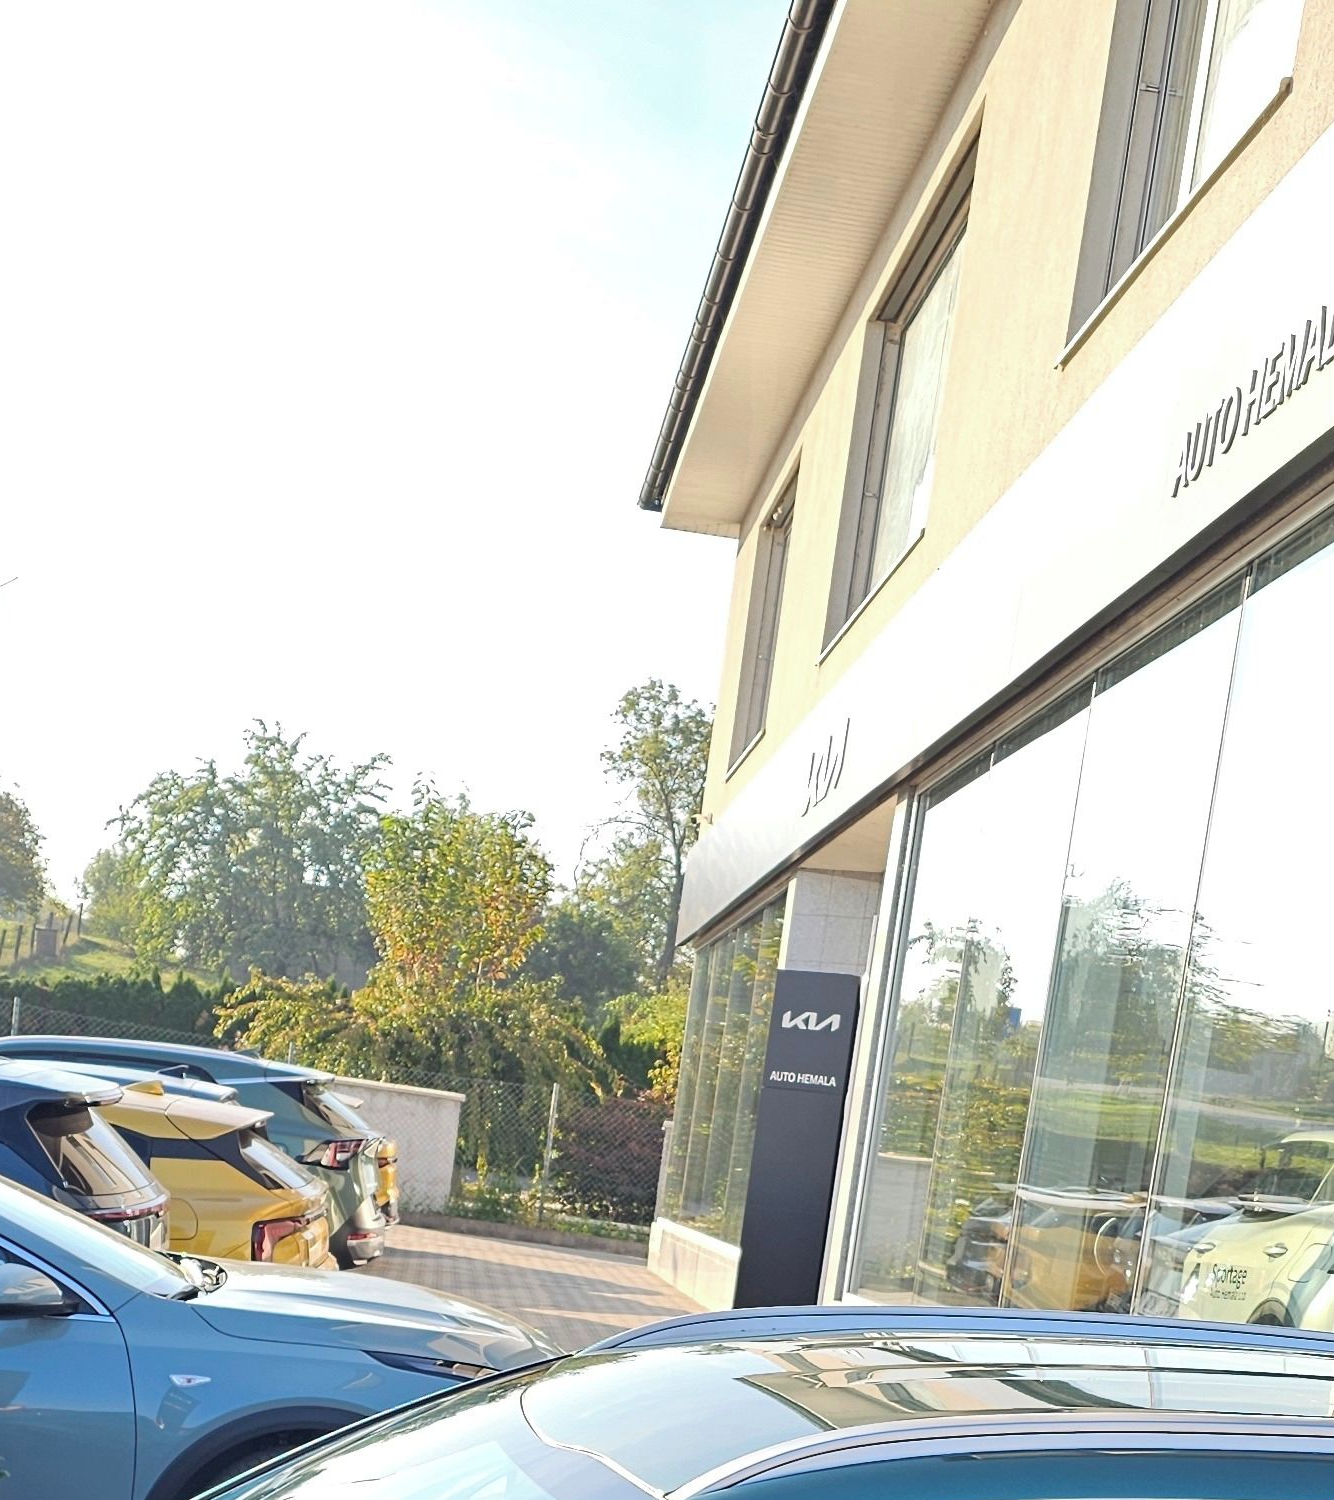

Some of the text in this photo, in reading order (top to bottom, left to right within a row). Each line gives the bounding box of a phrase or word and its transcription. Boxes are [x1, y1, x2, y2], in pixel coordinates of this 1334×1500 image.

[1170, 386, 1243, 498] AUTO
[781, 1010, 841, 1032] KIA
[769, 1070, 837, 1088] AUTO HEMALA
[1212, 1263, 1248, 1290] Sportage
